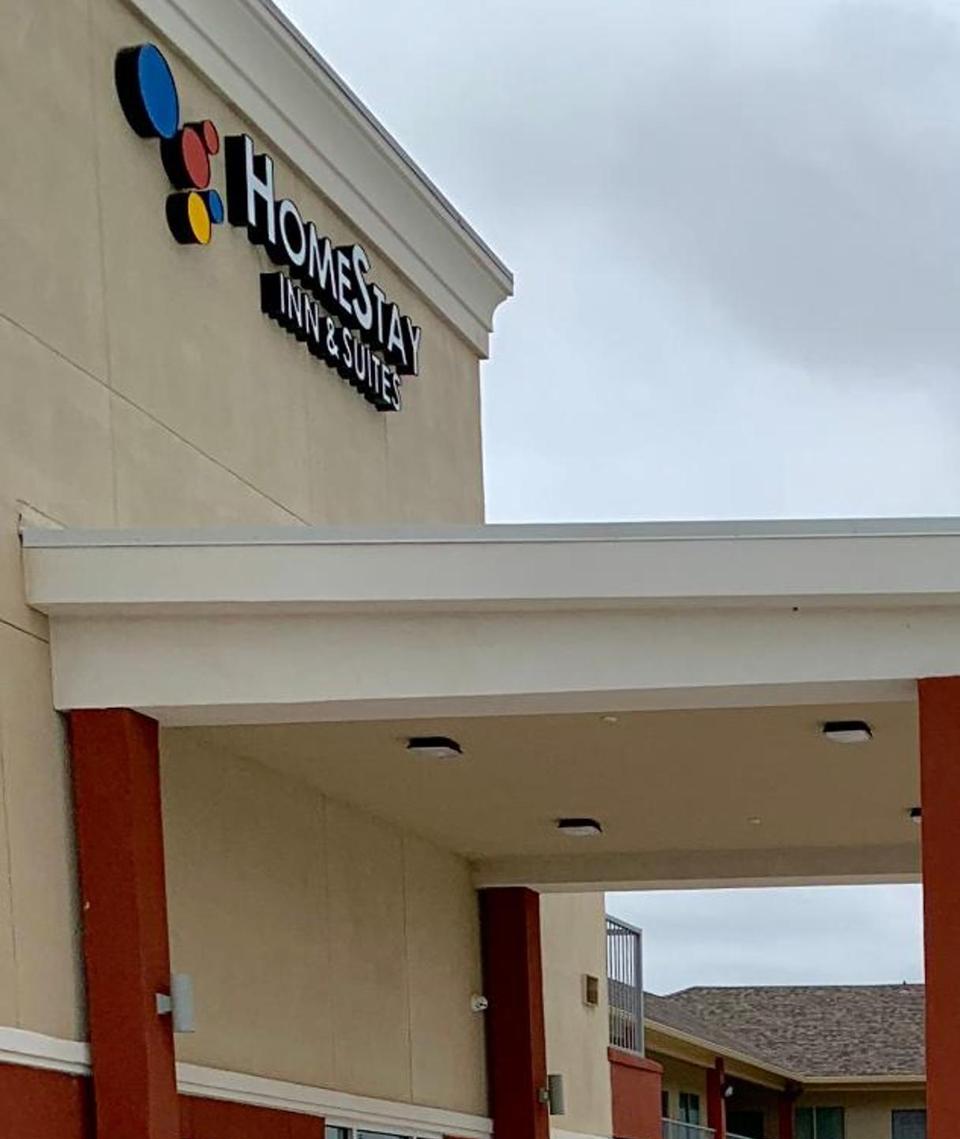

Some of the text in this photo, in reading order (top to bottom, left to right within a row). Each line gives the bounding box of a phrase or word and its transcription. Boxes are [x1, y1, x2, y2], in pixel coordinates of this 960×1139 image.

[243, 133, 421, 376] HOMESTAY
[279, 272, 401, 411] INN & SUITES
